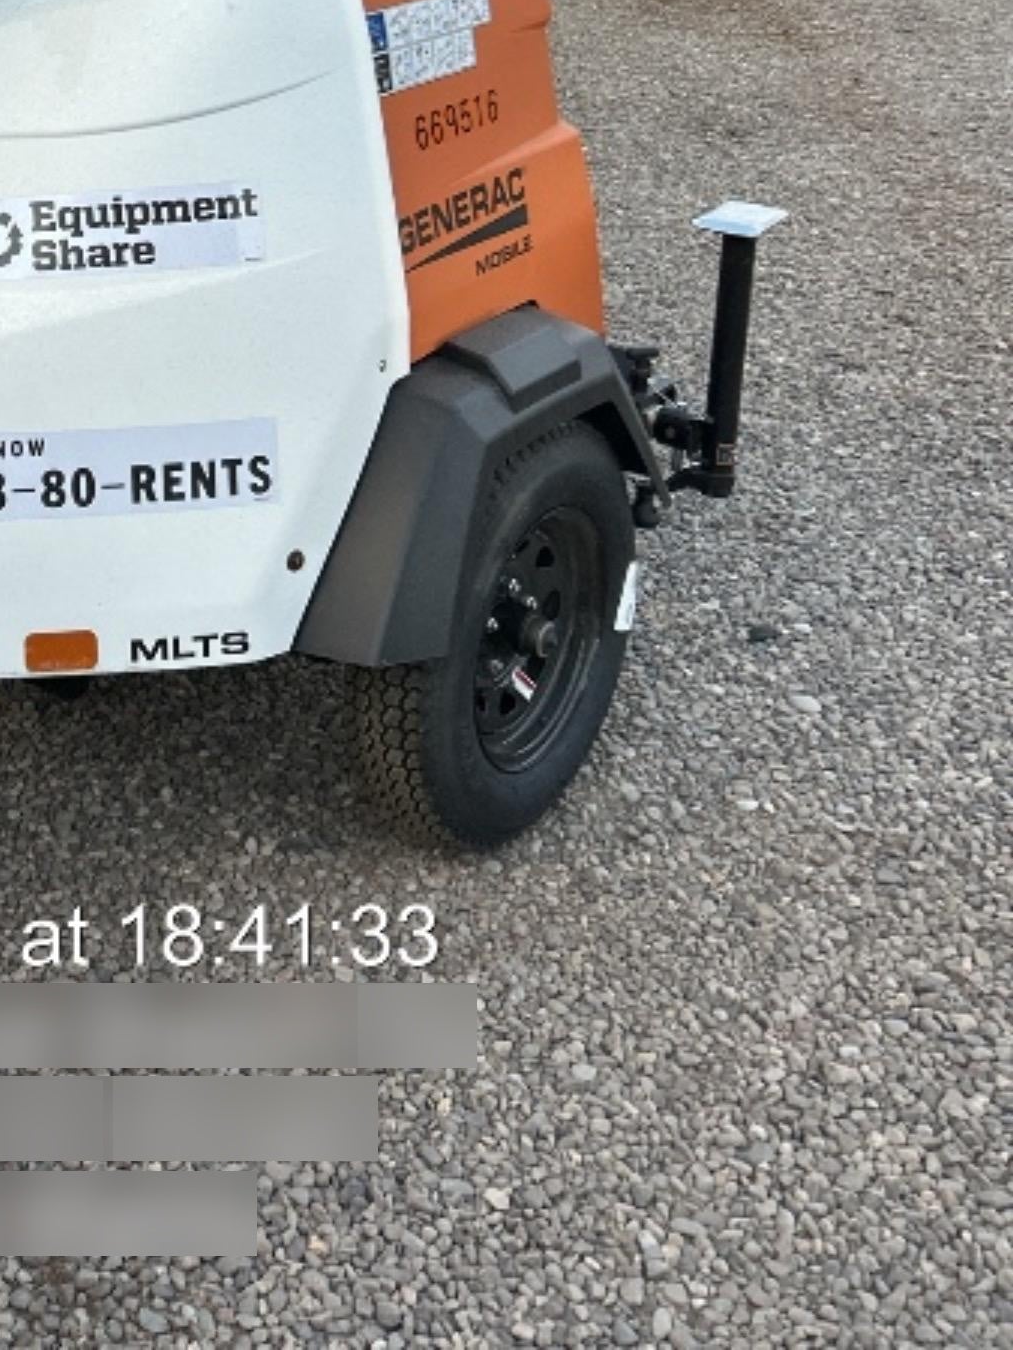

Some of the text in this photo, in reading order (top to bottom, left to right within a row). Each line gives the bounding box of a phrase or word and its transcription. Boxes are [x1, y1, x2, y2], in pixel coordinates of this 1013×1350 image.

[415, 89, 499, 150] 669516
[29, 188, 258, 237] Equipment
[398, 167, 526, 255] GENERAC
[31, 240, 156, 270] Share
[475, 234, 534, 276] MOBILE
[130, 632, 250, 662] MLTS
